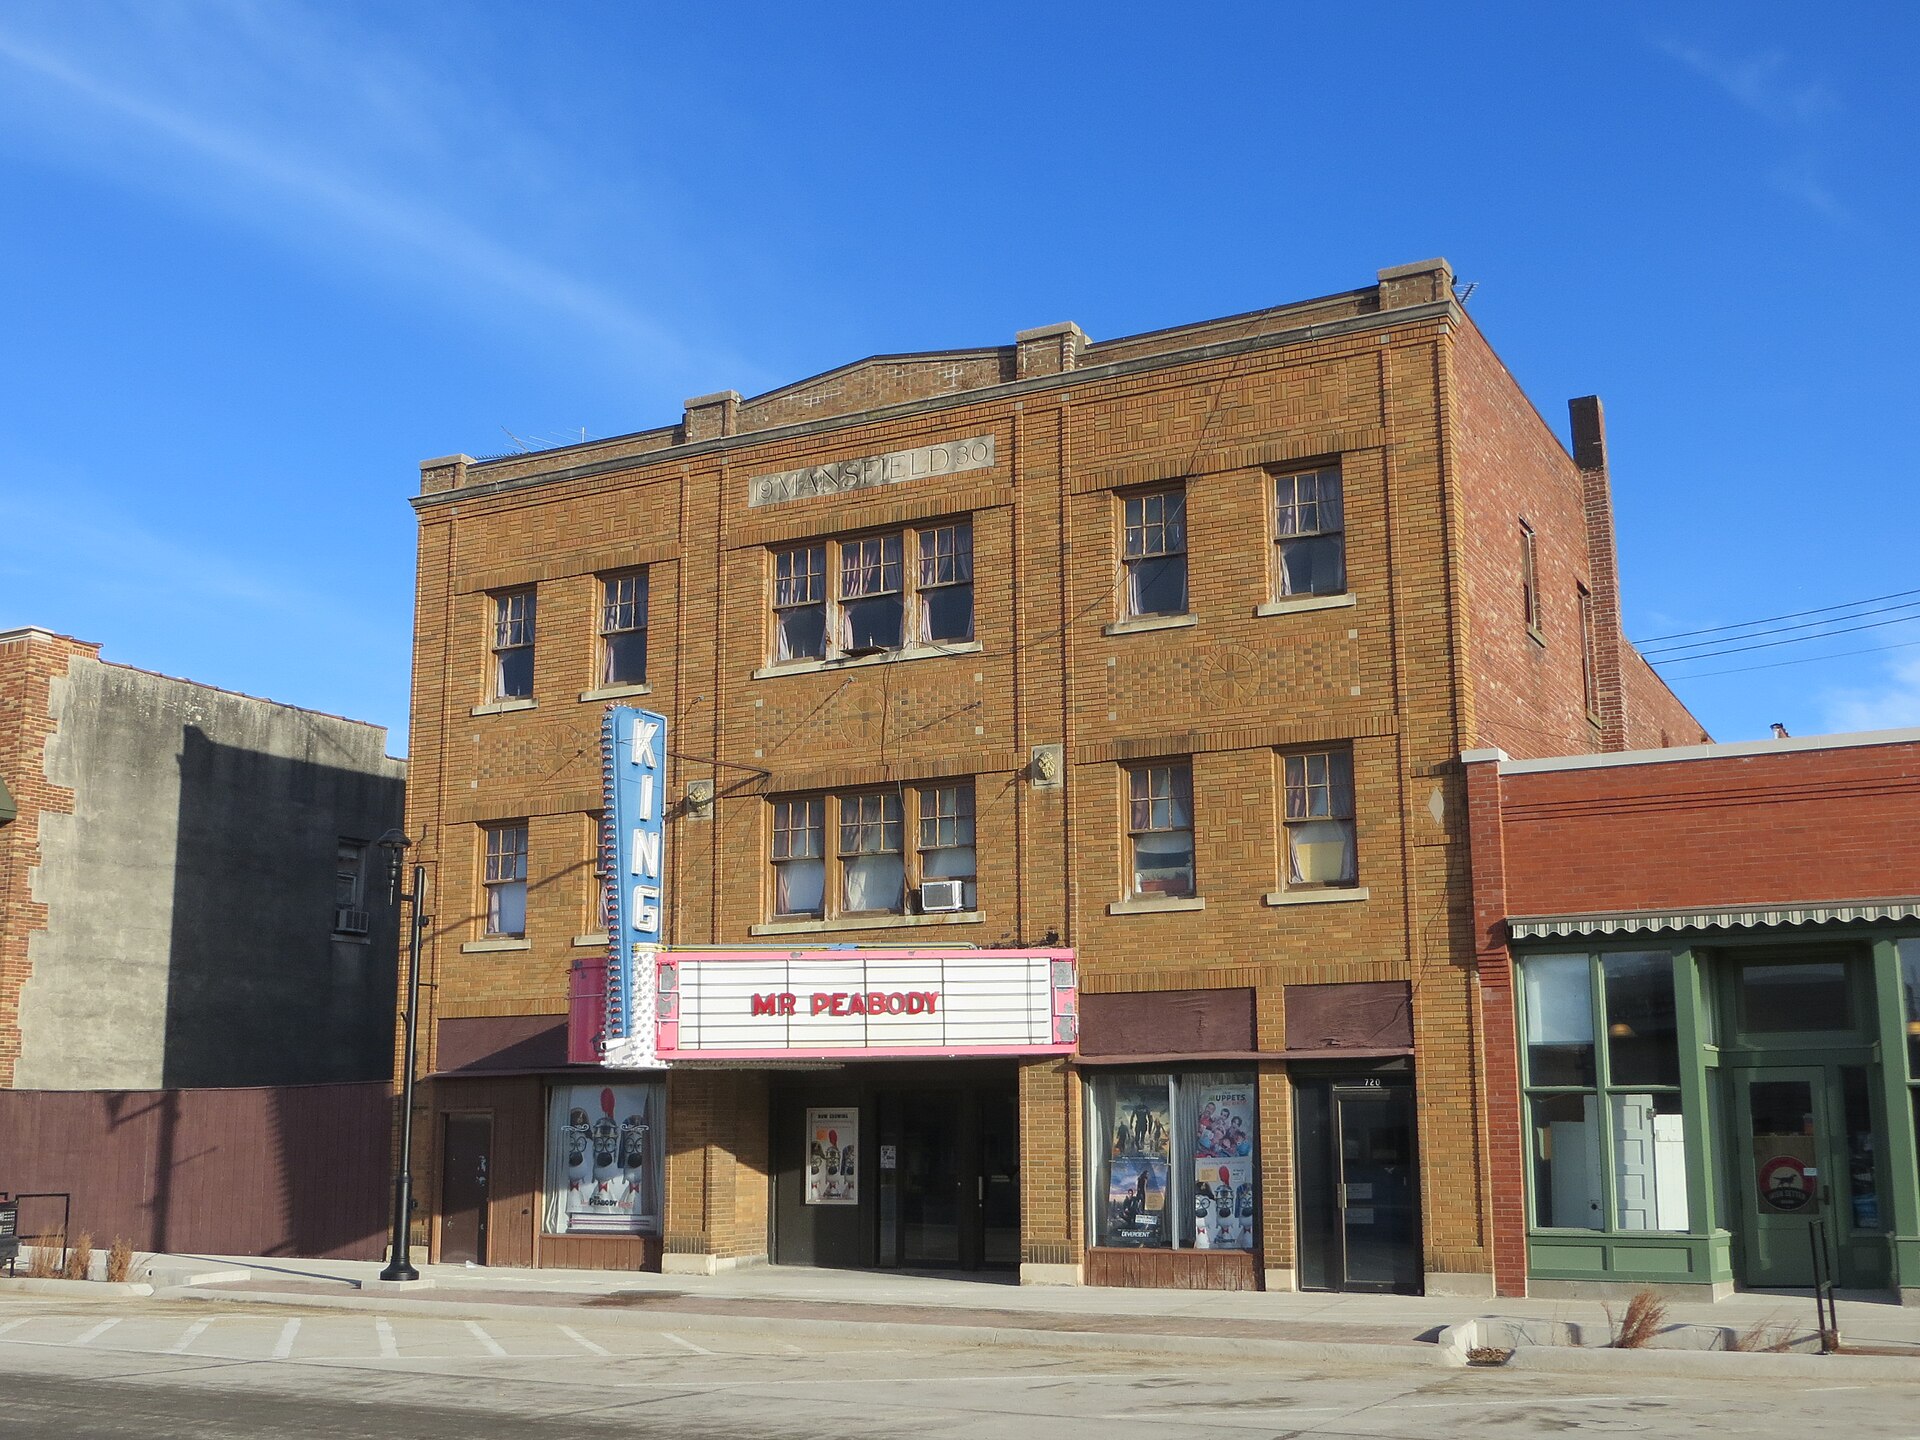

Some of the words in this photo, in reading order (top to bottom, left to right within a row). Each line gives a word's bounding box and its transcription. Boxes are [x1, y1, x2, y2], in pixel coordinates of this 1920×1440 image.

[754, 480, 774, 503] 19
[776, 446, 951, 497] MANSFIELD
[955, 441, 989, 466] 30
[631, 717, 659, 934] KING
[752, 992, 797, 1017] MR
[811, 990, 940, 1017] PEABODY
[1364, 1078, 1381, 1086] 720
